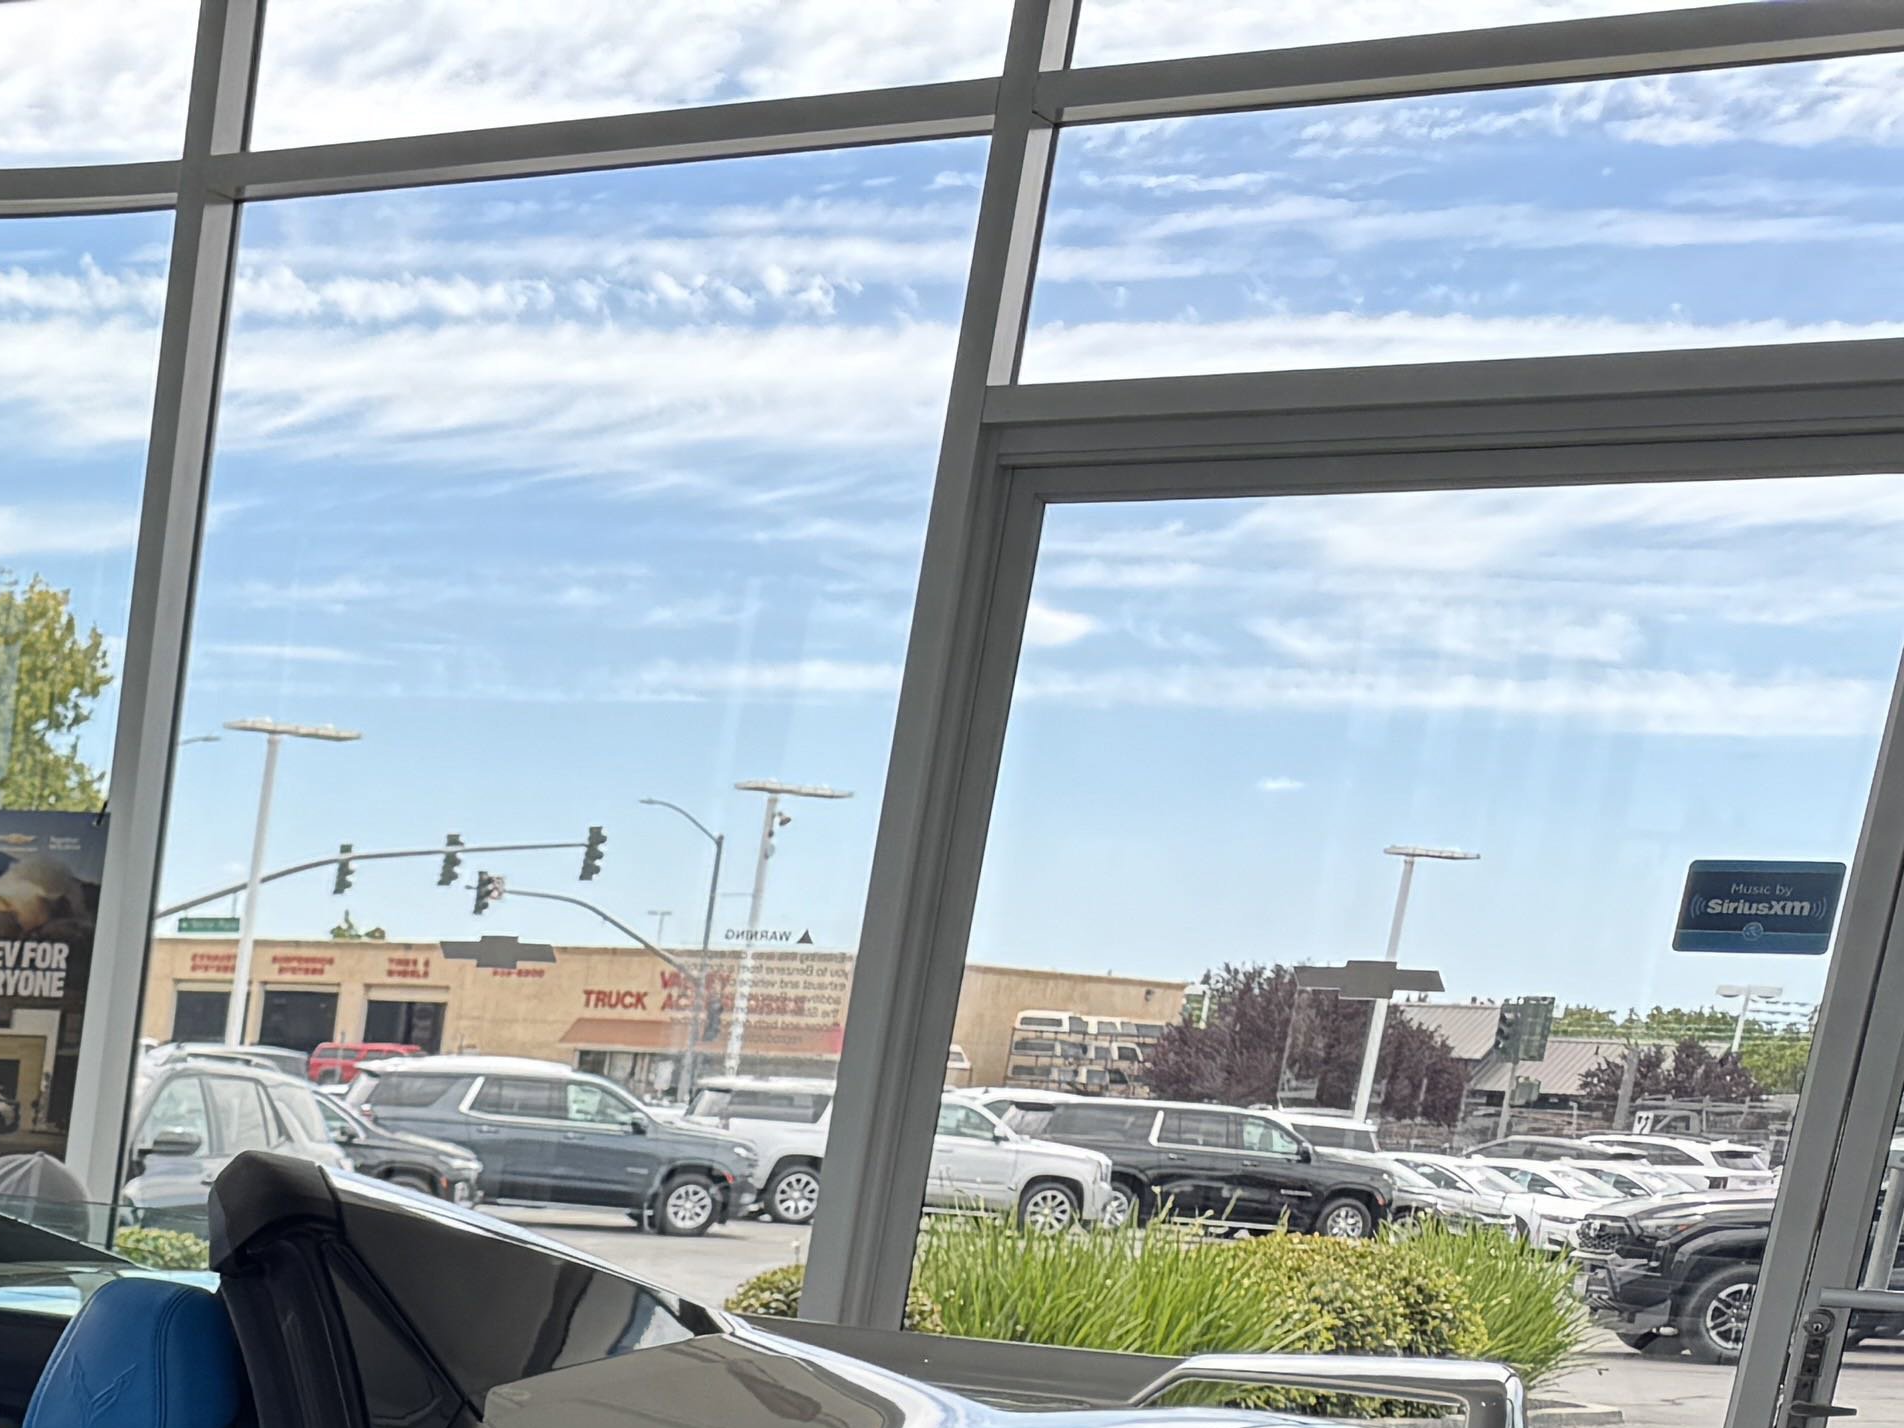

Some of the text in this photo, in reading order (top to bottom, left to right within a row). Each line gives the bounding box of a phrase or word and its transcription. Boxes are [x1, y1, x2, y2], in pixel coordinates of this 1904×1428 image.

[1731, 883, 1793, 897] Music by
[21, 941, 70, 970] FOR
[583, 989, 648, 1011] TRUCK
